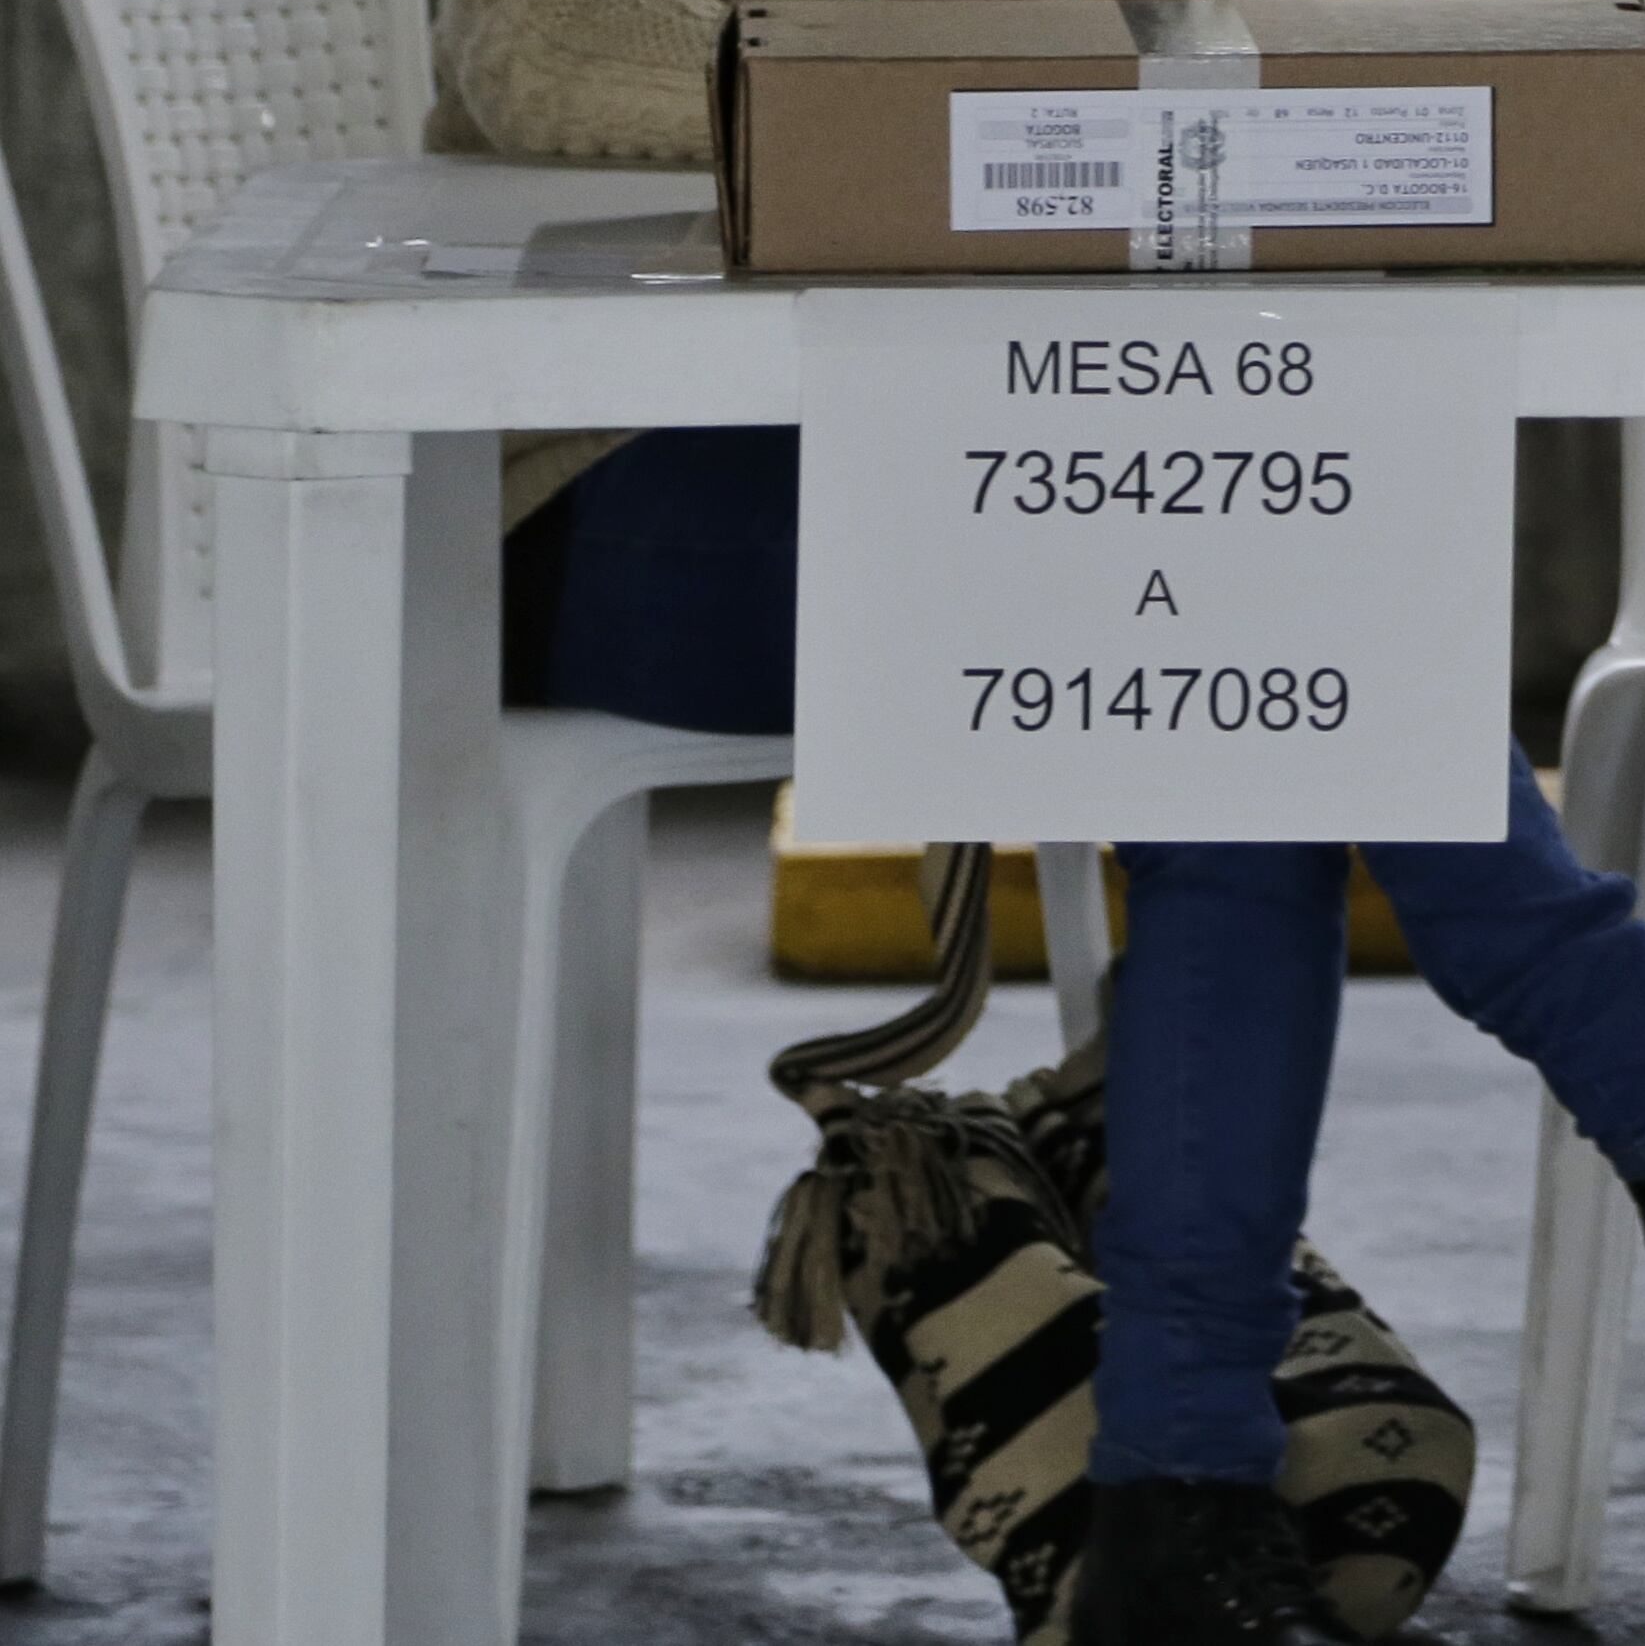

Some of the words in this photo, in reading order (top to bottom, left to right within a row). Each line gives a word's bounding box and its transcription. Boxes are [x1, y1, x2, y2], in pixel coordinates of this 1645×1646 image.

[1294, 157, 1358, 171] USAQUEN
[1373, 157, 1469, 170] 01-LOCALIDAD
[1391, 183, 1468, 195] 16-BOGOTA
[1157, 143, 1174, 260] ELECTORAL
[1007, 340, 1214, 396] MESA
[1236, 341, 1314, 397] 68
[965, 450, 1352, 516] 73542795
[1135, 569, 1179, 616] A
[962, 667, 1349, 732] 79147089
